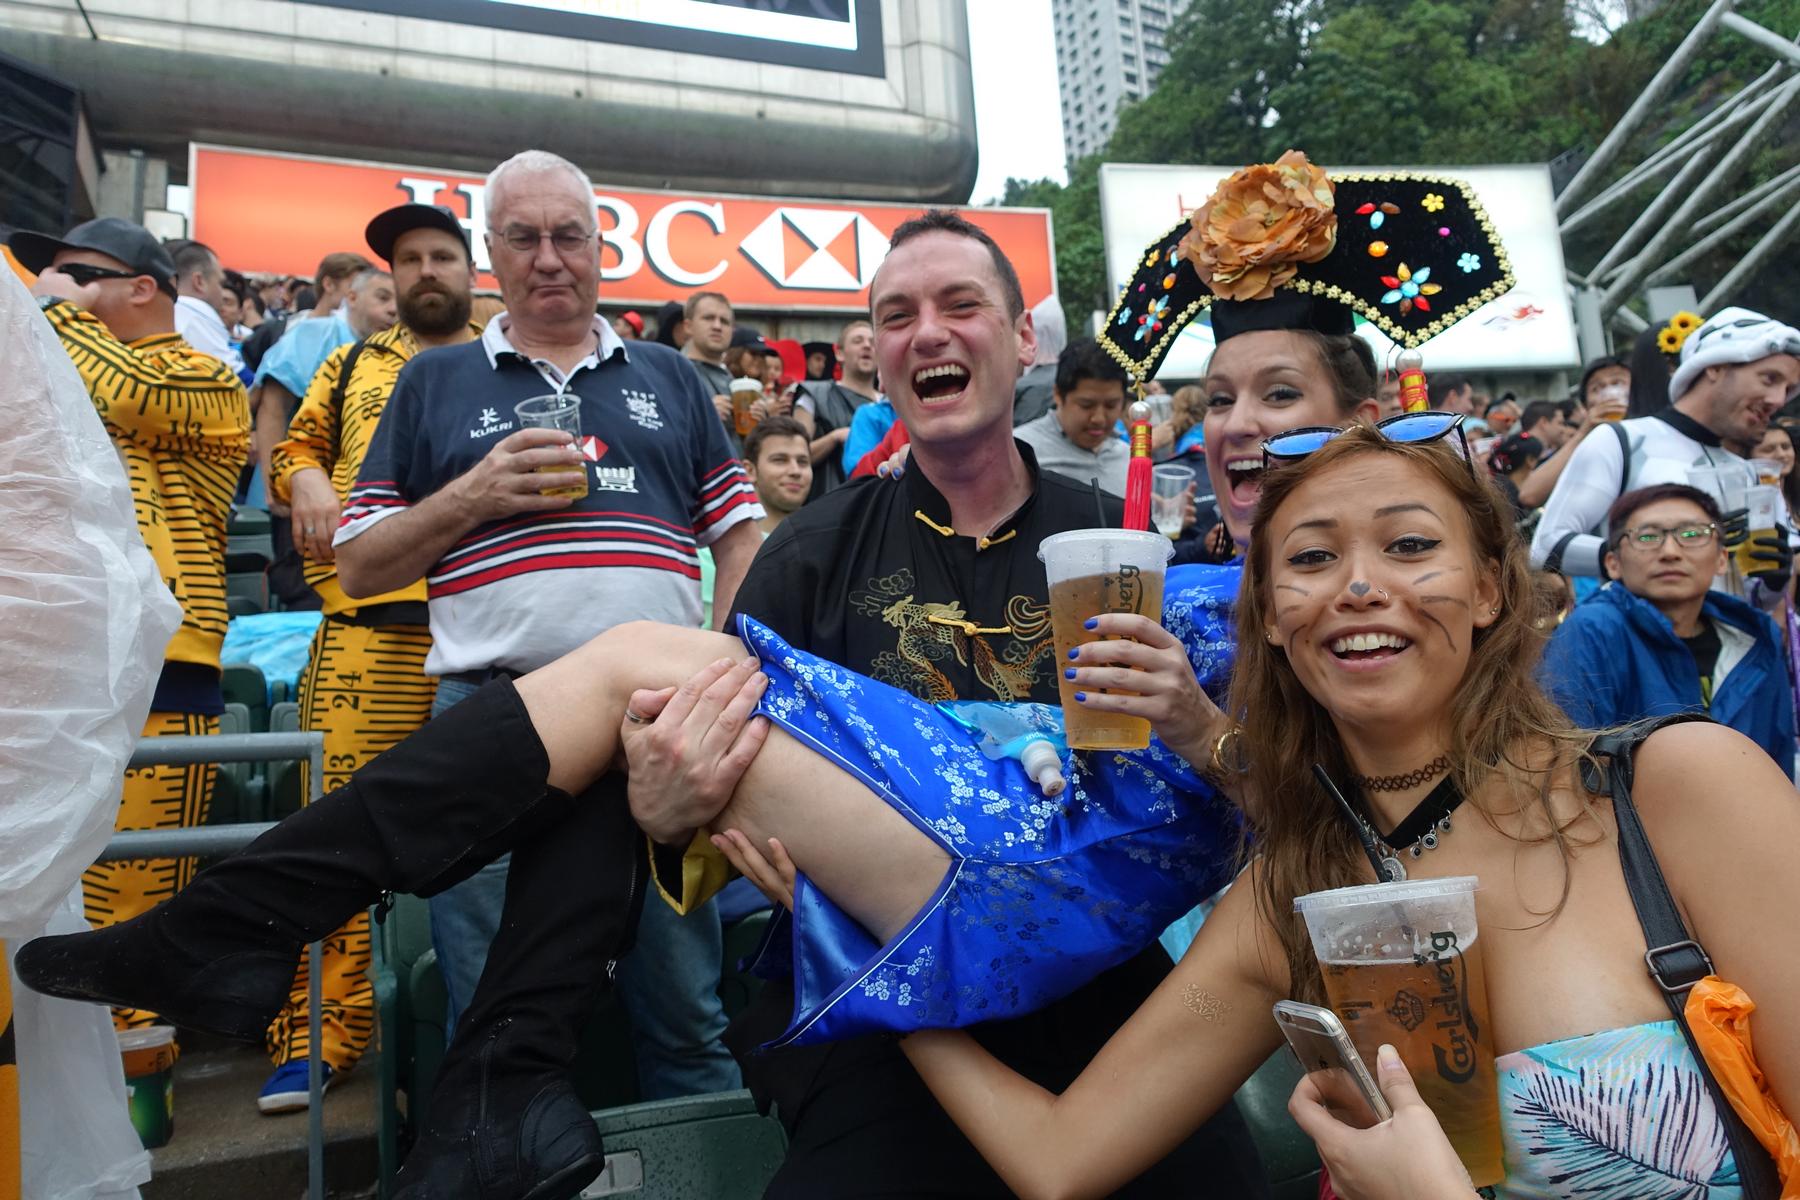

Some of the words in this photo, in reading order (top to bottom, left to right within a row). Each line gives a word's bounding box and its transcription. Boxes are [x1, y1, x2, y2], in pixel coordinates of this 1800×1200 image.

[397, 177, 729, 288] HBC
[470, 420, 513, 439] KUKRI
[332, 670, 362, 711] 24
[1430, 930, 1479, 1084] Carlsberg
